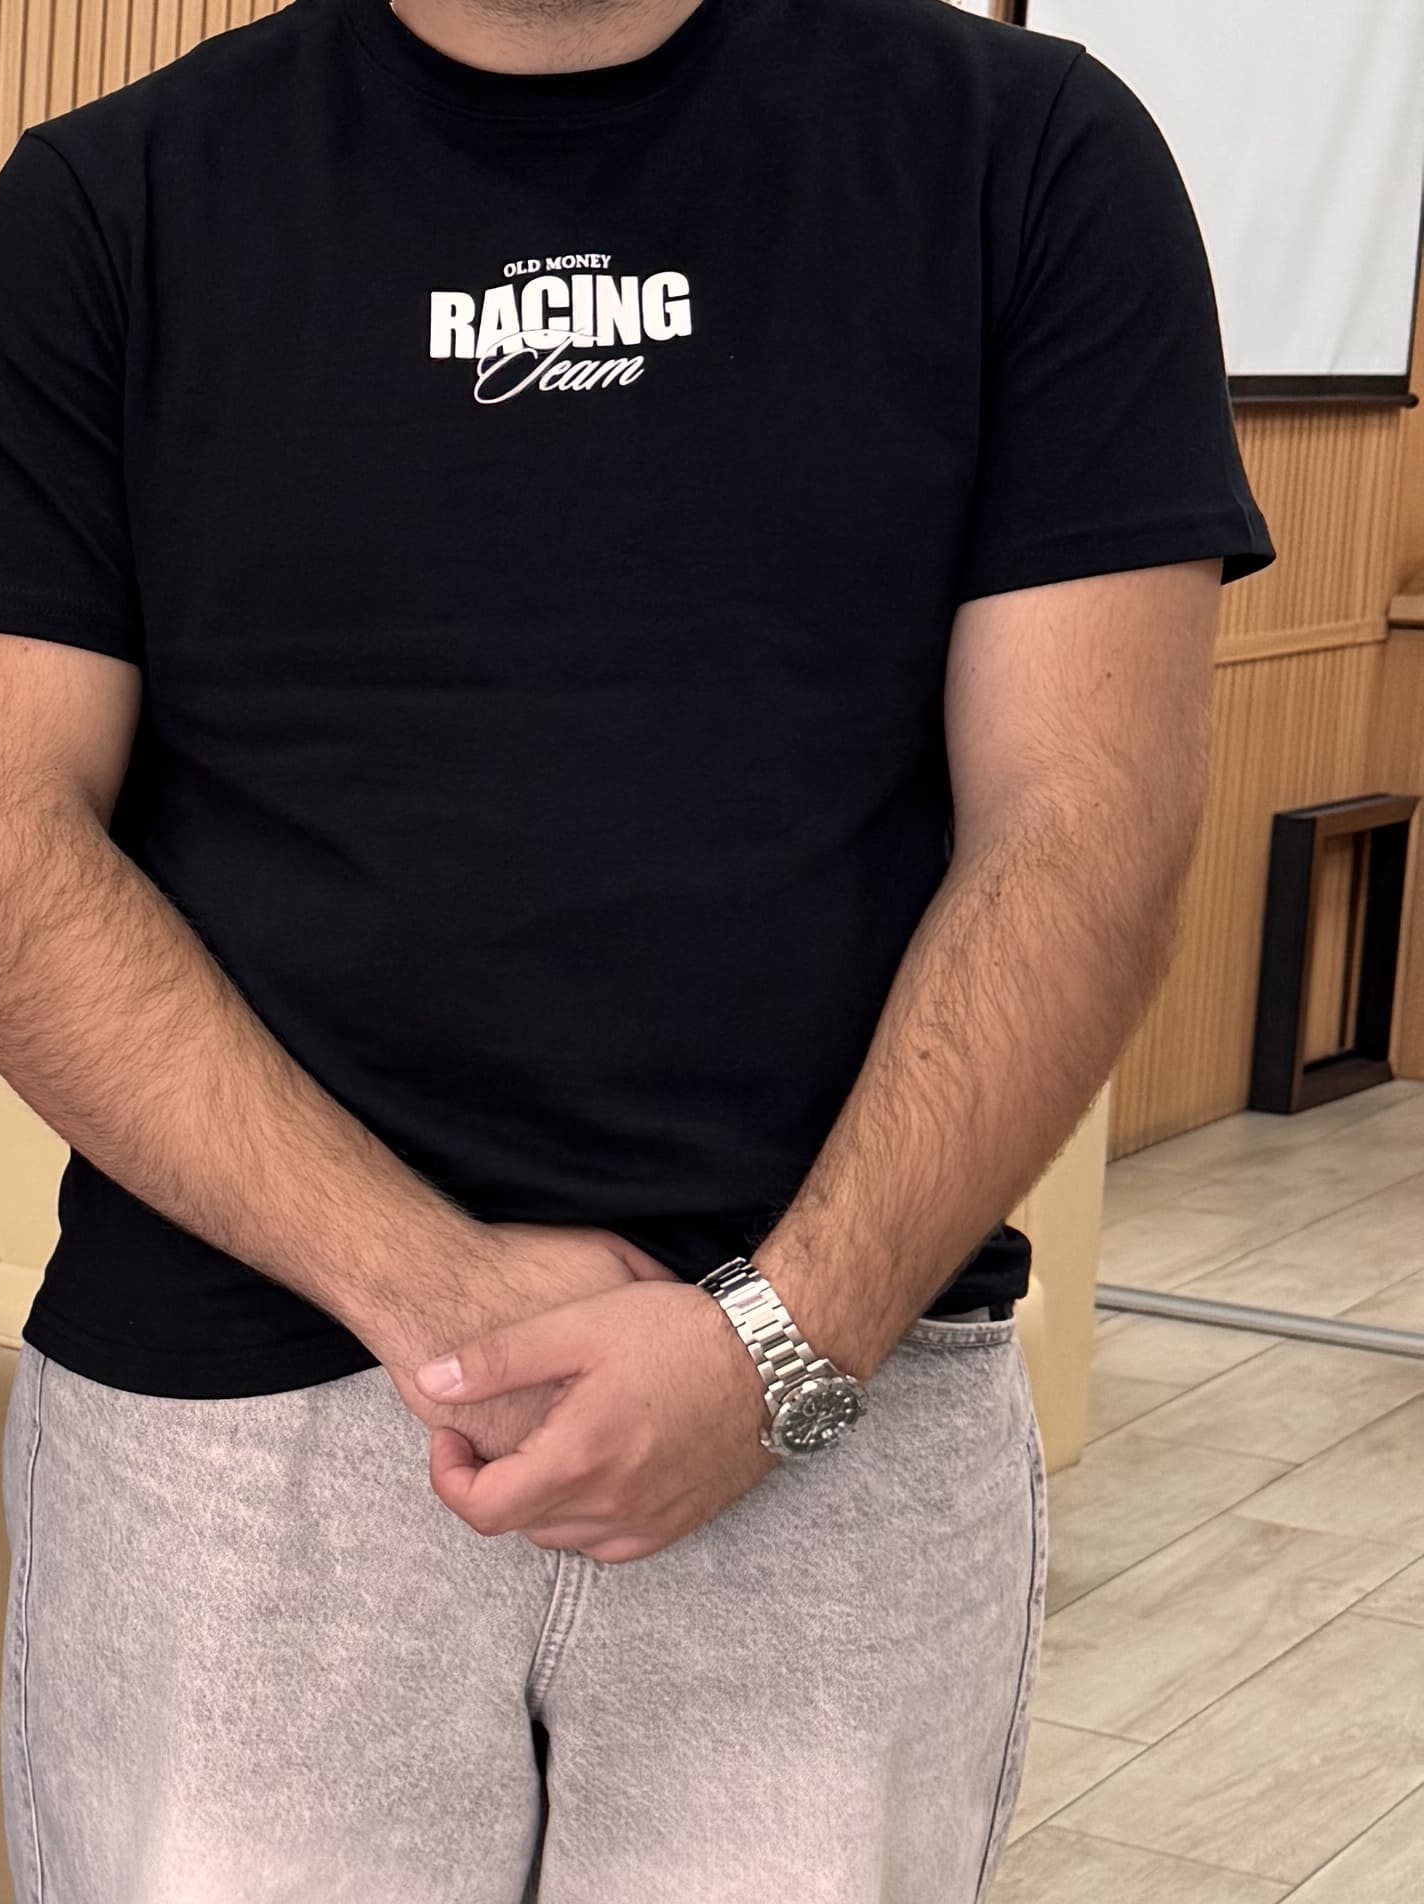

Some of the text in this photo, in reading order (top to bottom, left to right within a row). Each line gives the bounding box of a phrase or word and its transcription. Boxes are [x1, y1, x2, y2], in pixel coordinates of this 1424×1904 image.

[503, 254, 611, 278] OLD MONEY
[429, 271, 692, 360] RACING
[473, 328, 646, 405] Team
